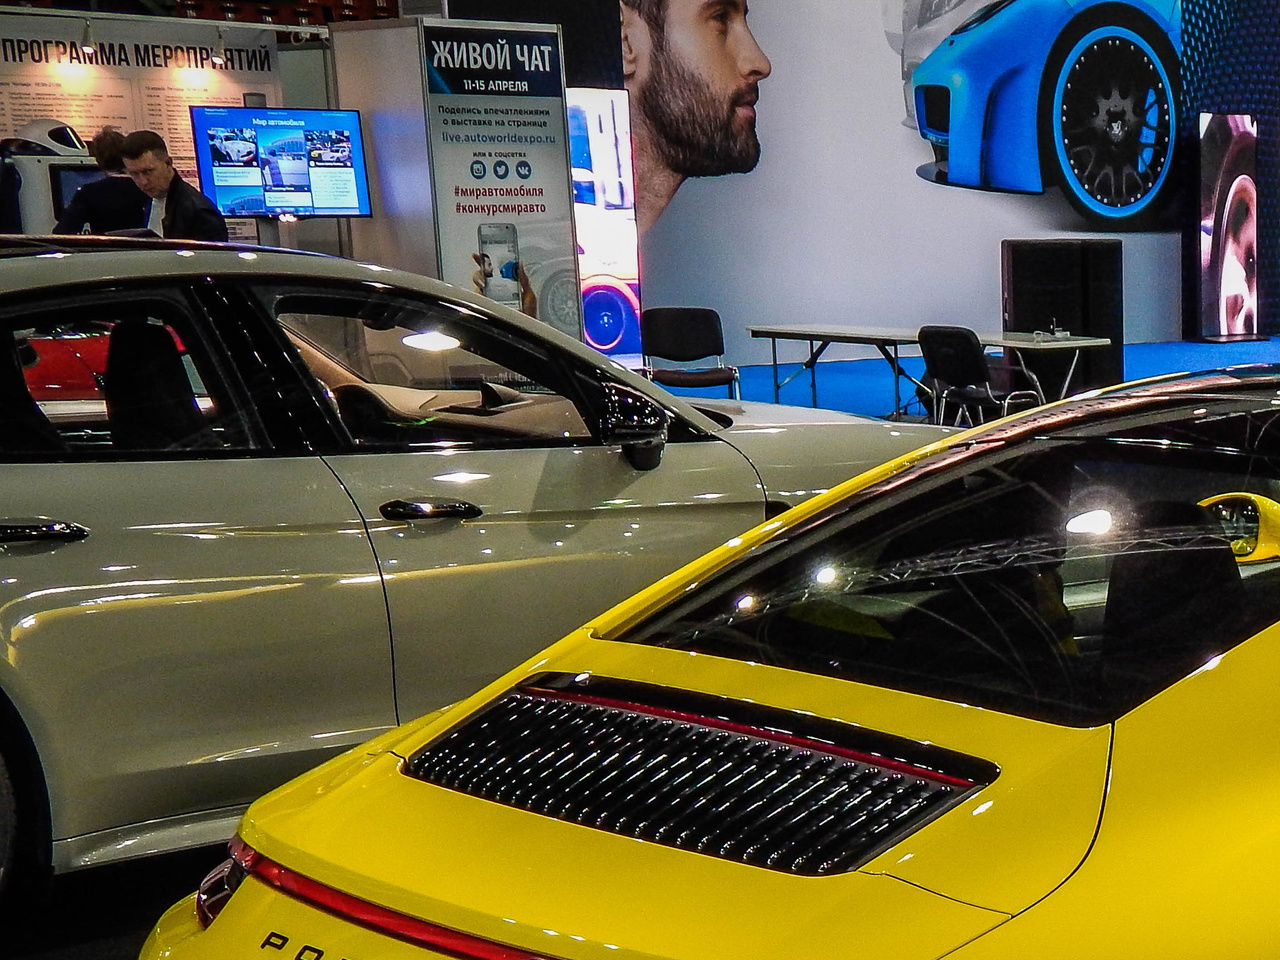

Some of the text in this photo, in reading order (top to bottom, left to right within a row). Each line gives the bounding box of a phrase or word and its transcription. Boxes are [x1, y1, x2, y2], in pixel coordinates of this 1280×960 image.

[1, 37, 131, 67] ПРОГРАММА
[431, 39, 552, 72] ЖИВОЙ ЧАТ
[463, 79, 529, 92] 11-15 АПРЕЛЯ
[438, 105, 550, 116] Поделись впечатлениями
[252, 117, 267, 127] Мир
[442, 118, 548, 128] о выставке на странице
[442, 131, 556, 145] live.autoworldexpo.ru
[494, 151, 527, 160] соцсетях
[454, 184, 544, 200] #миравтомобиля
[455, 202, 546, 216] #конкурсмиравто
